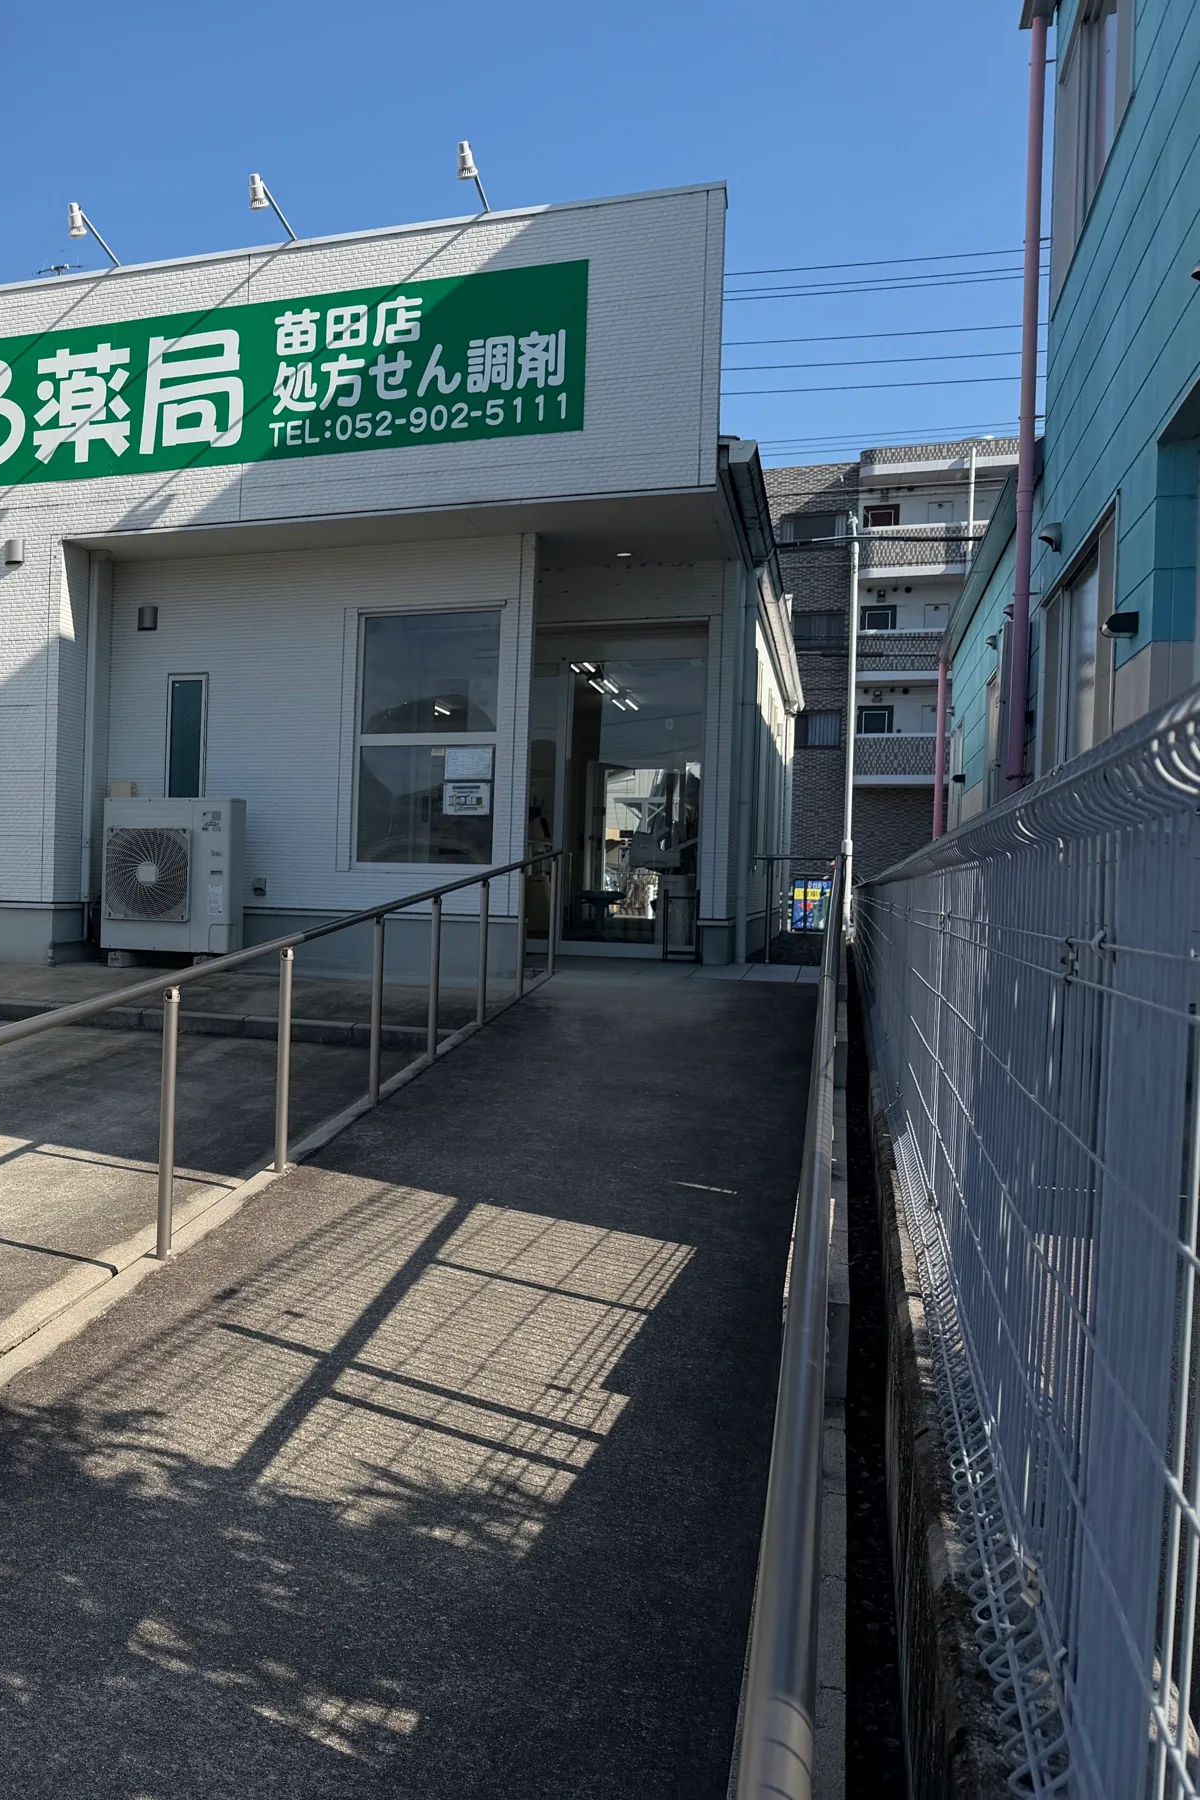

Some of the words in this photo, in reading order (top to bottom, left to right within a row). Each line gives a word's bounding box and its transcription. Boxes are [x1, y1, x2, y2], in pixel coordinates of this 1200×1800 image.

[274, 296, 423, 356] 苗田店
[273, 329, 566, 415] 処方せん調剤
